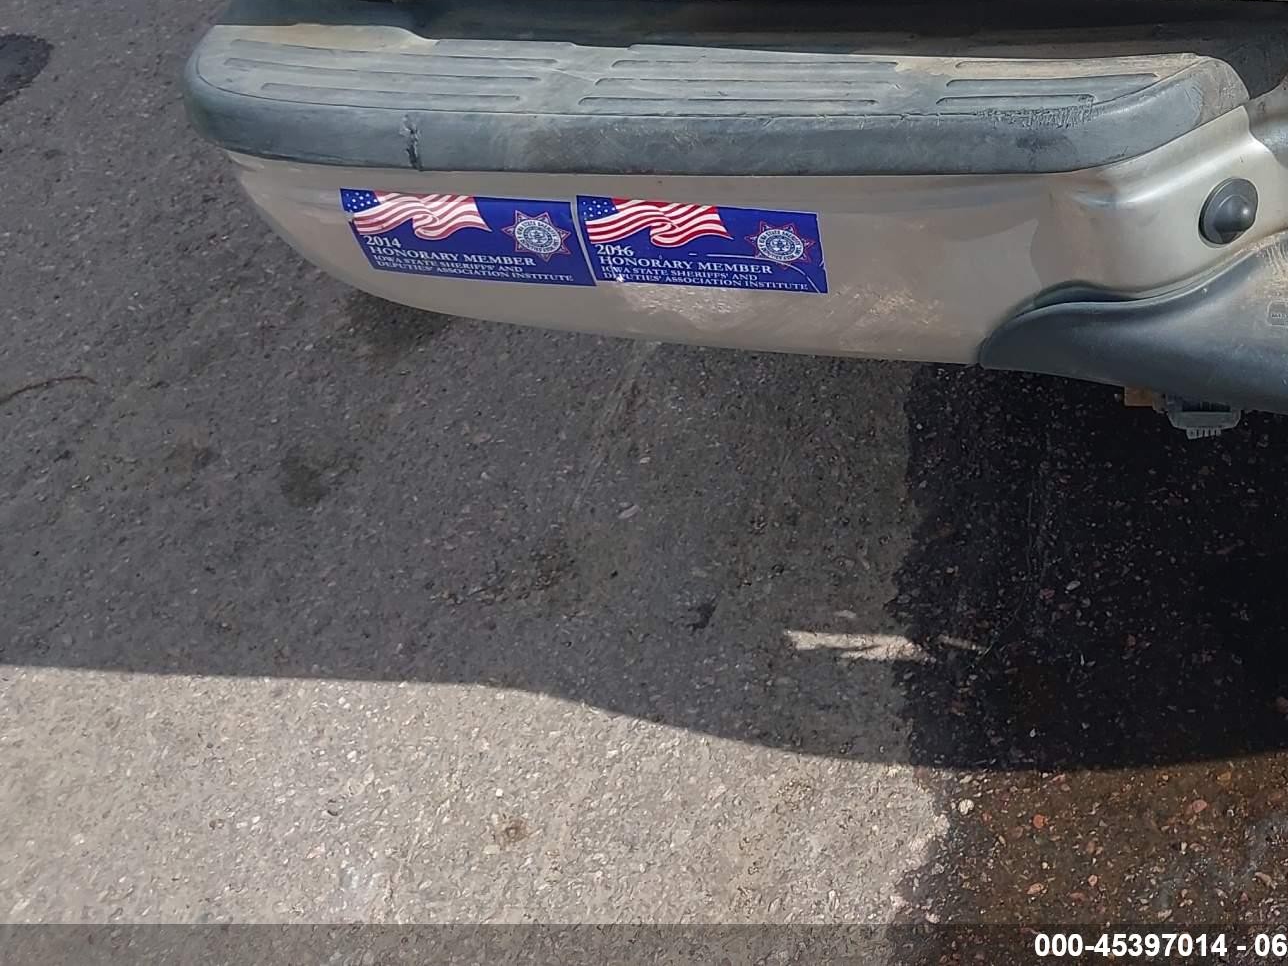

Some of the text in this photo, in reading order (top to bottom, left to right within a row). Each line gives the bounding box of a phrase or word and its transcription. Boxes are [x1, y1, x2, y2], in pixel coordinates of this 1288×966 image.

[363, 235, 401, 248] 2014
[369, 246, 537, 266] HONORARY MEMBER
[595, 244, 634, 257] 2016
[373, 254, 403, 264] IOWA
[402, 258, 438, 267] STATE
[599, 255, 773, 274] HONORARY MEMBER
[436, 266, 510, 278] ASSOCIATION
[512, 273, 575, 282] INSTITUTE
[601, 266, 631, 274] IOWA
[632, 267, 668, 276] STATE
[732, 273, 758, 281] AND
[665, 276, 742, 287] ASSOCIATION
[745, 281, 809, 291] INSTITUTE
